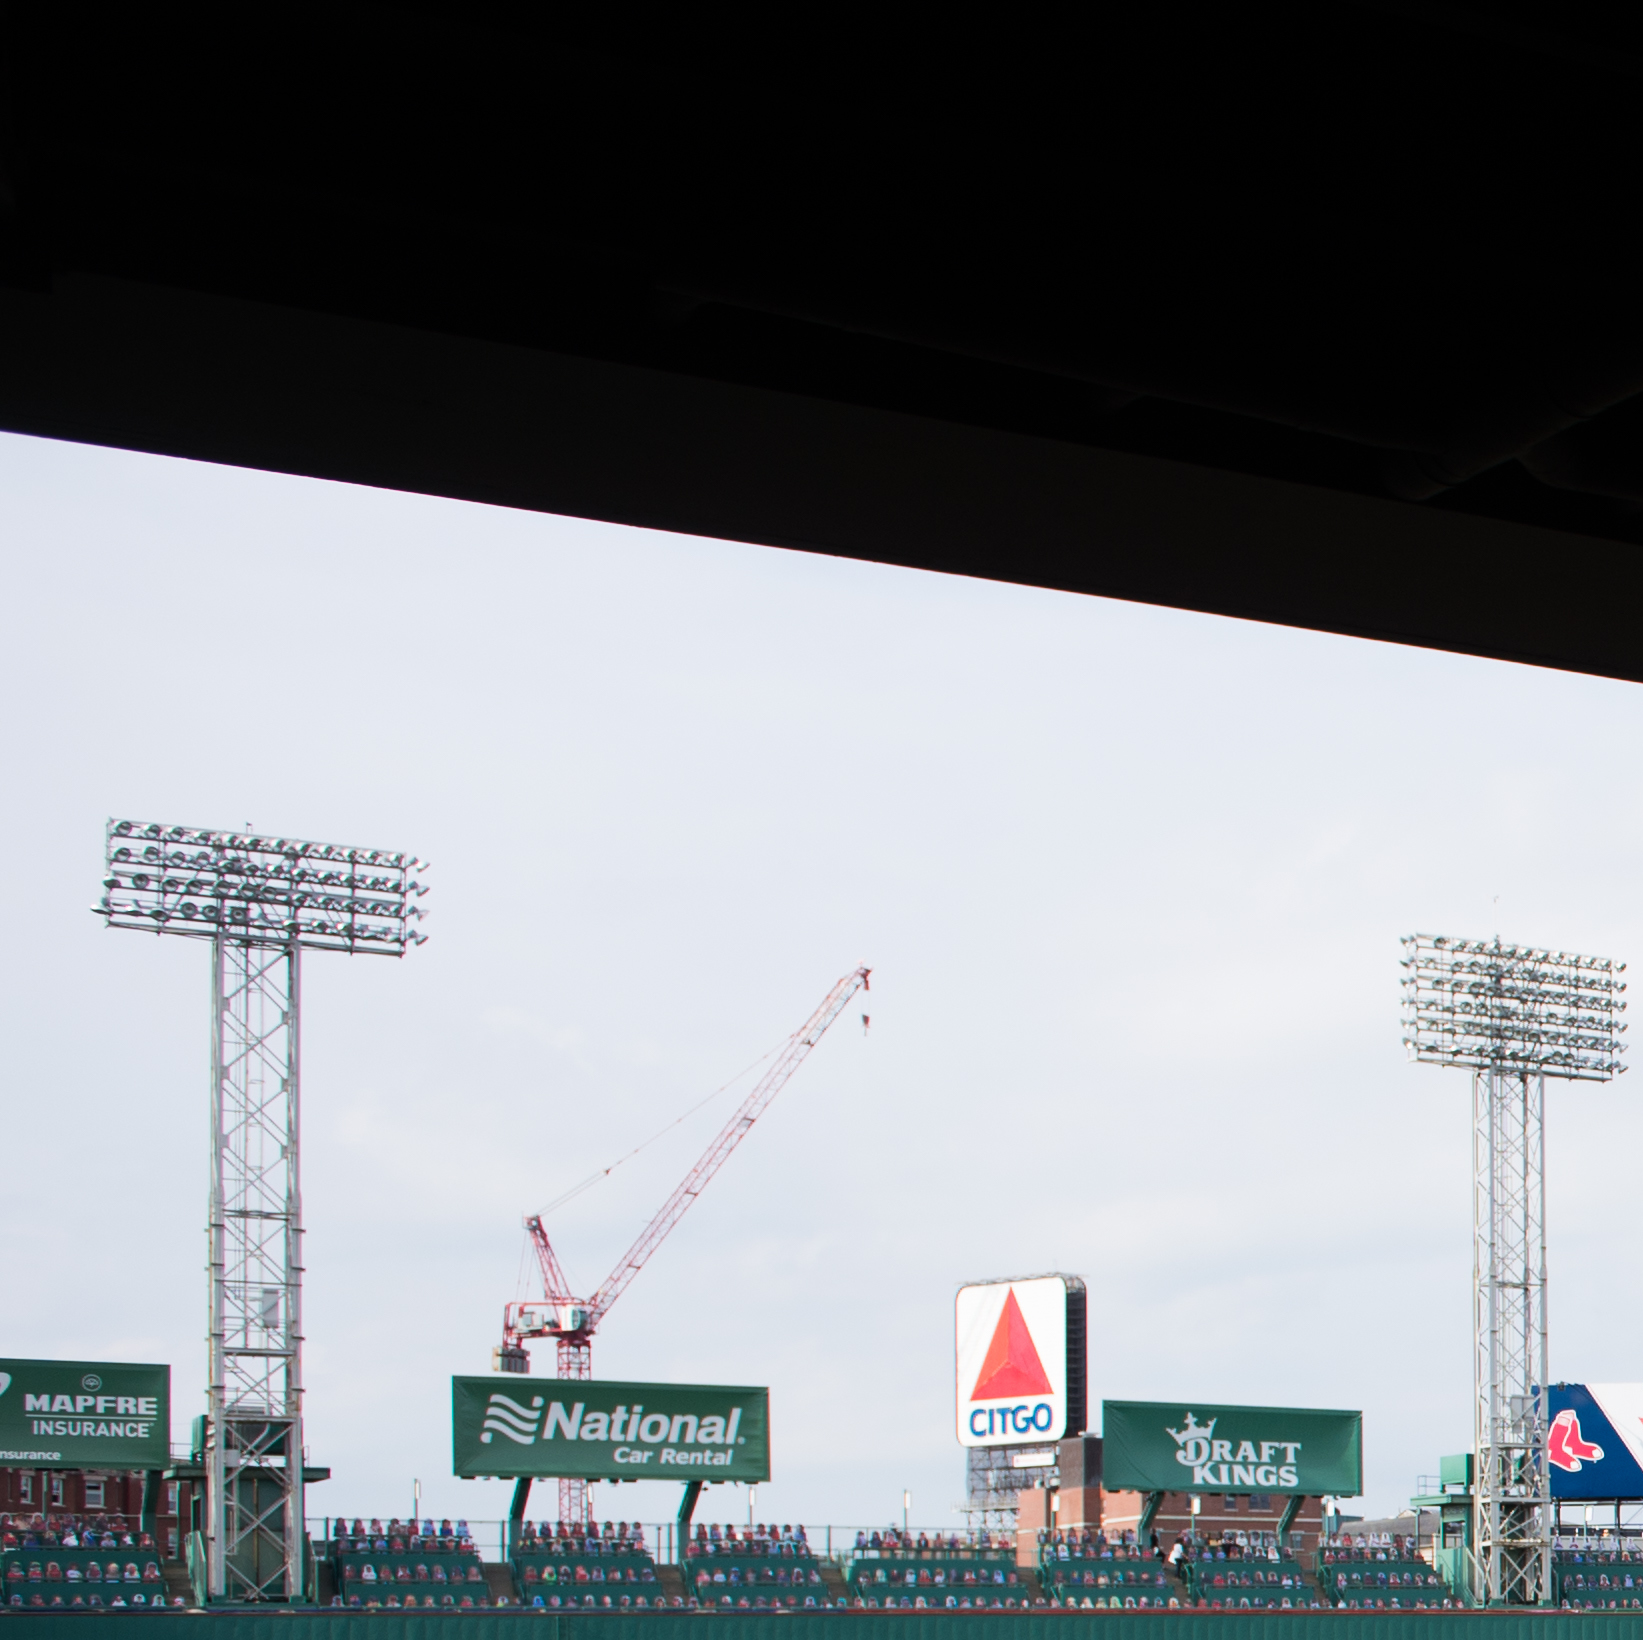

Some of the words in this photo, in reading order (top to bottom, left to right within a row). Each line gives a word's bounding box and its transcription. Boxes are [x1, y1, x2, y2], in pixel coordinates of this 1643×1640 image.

[25, 1394, 157, 1415] MAPFRE
[33, 1420, 150, 1437] INSURANCE
[542, 1402, 741, 1445] National
[970, 1403, 1053, 1437] CITGO
[614, 1447, 656, 1466] Car
[660, 1448, 733, 1467] Rental
[1176, 1437, 1300, 1467] DRAFT
[1194, 1463, 1299, 1488] KINGS
